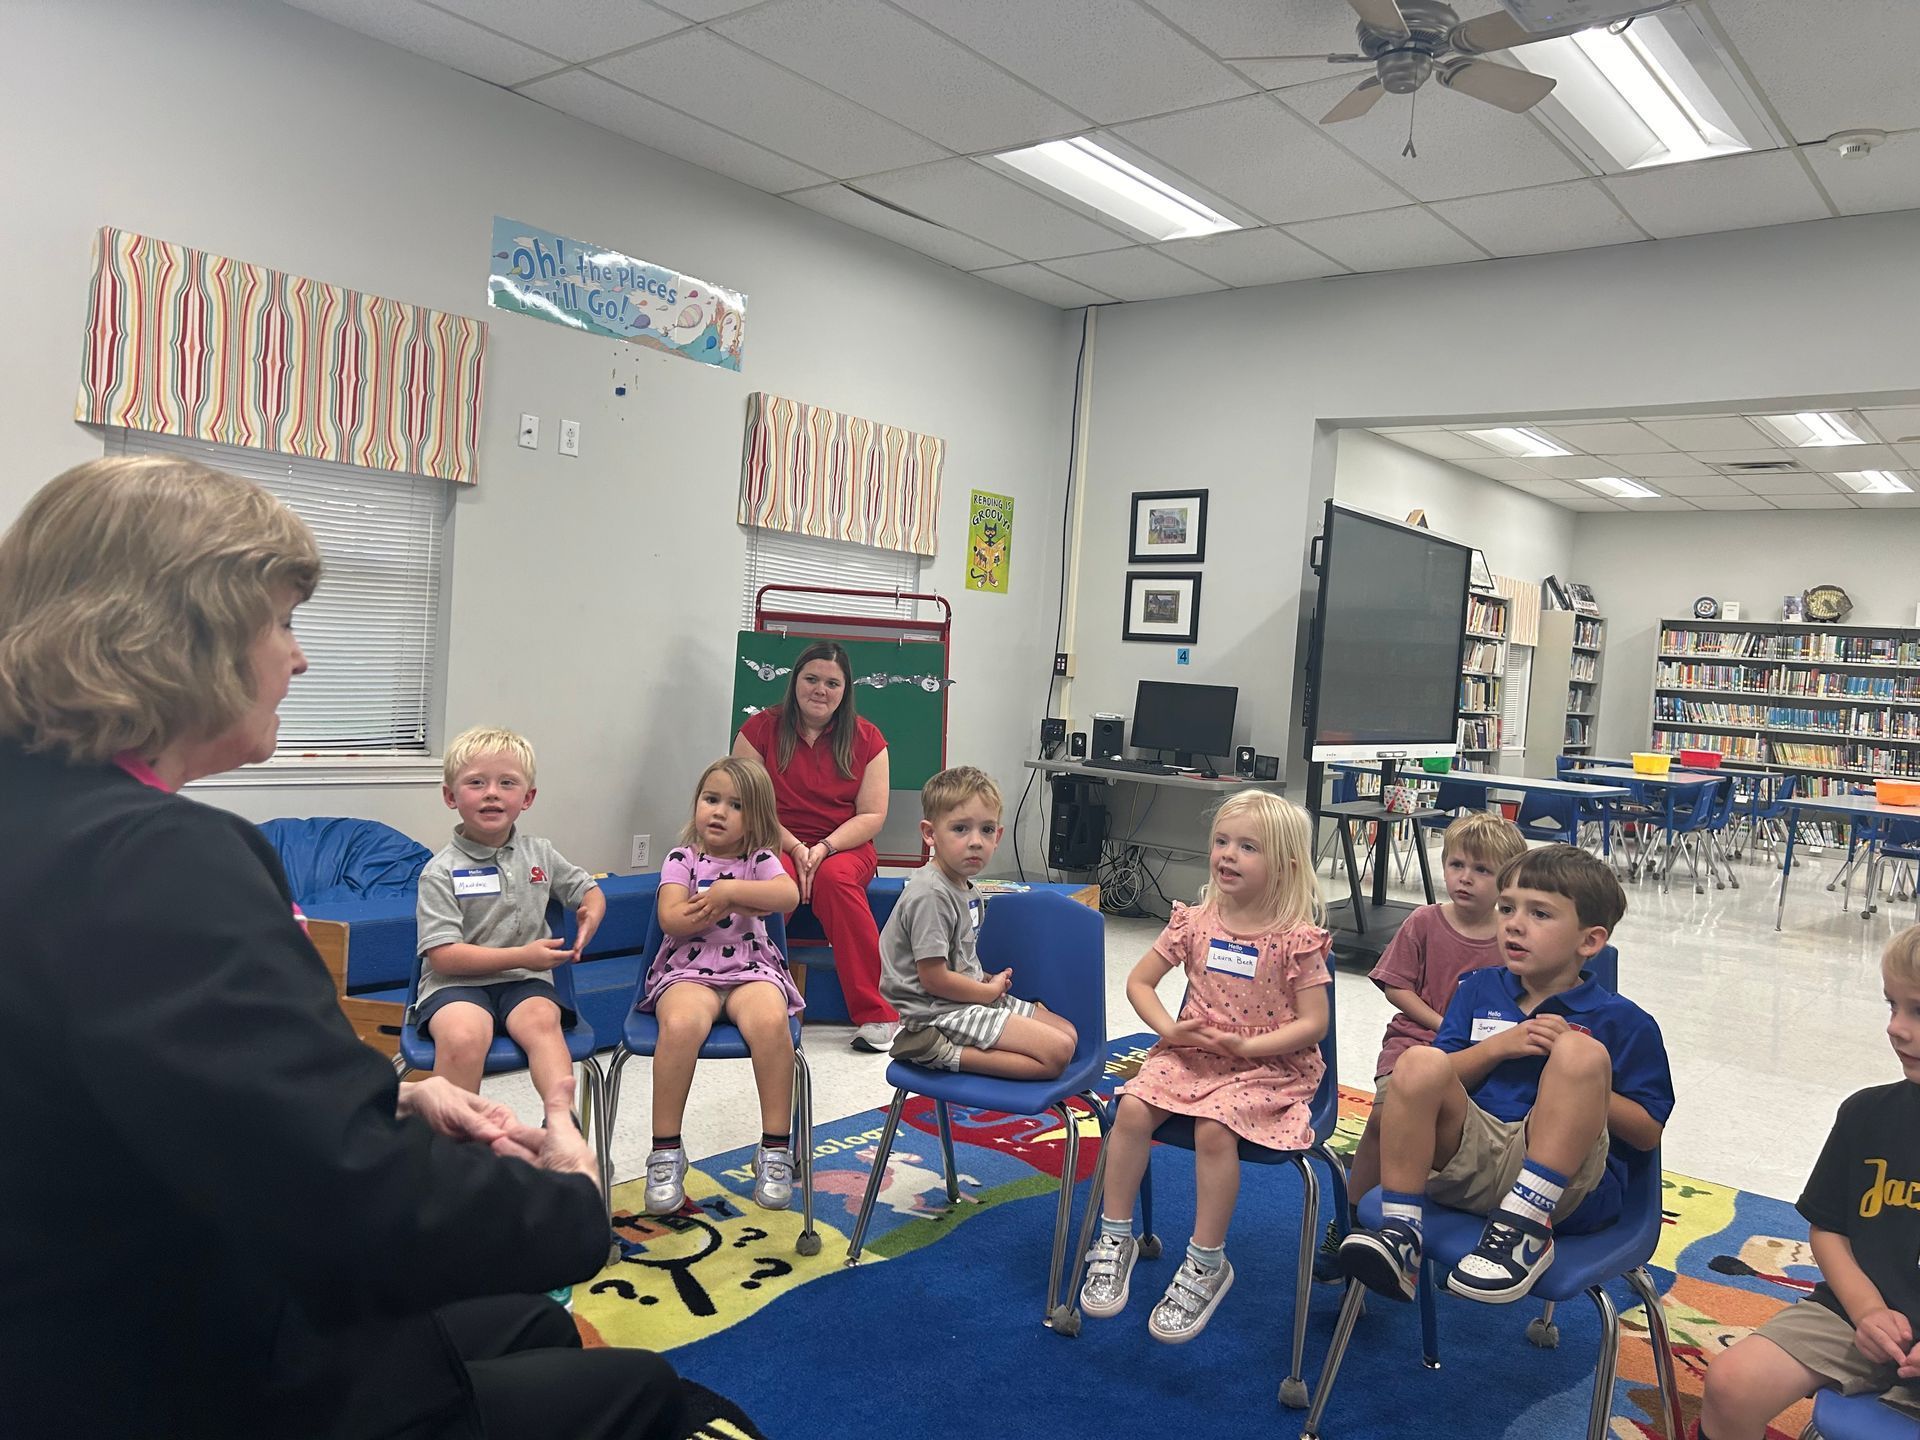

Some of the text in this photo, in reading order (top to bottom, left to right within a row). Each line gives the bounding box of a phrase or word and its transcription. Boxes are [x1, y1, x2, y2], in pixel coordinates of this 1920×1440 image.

[512, 238, 678, 305] Oh! the Places
[587, 289, 630, 323] Go!
[973, 494, 1012, 511] READING IS
[1179, 650, 1187, 662] 4
[1228, 943, 1243, 951] Hello
